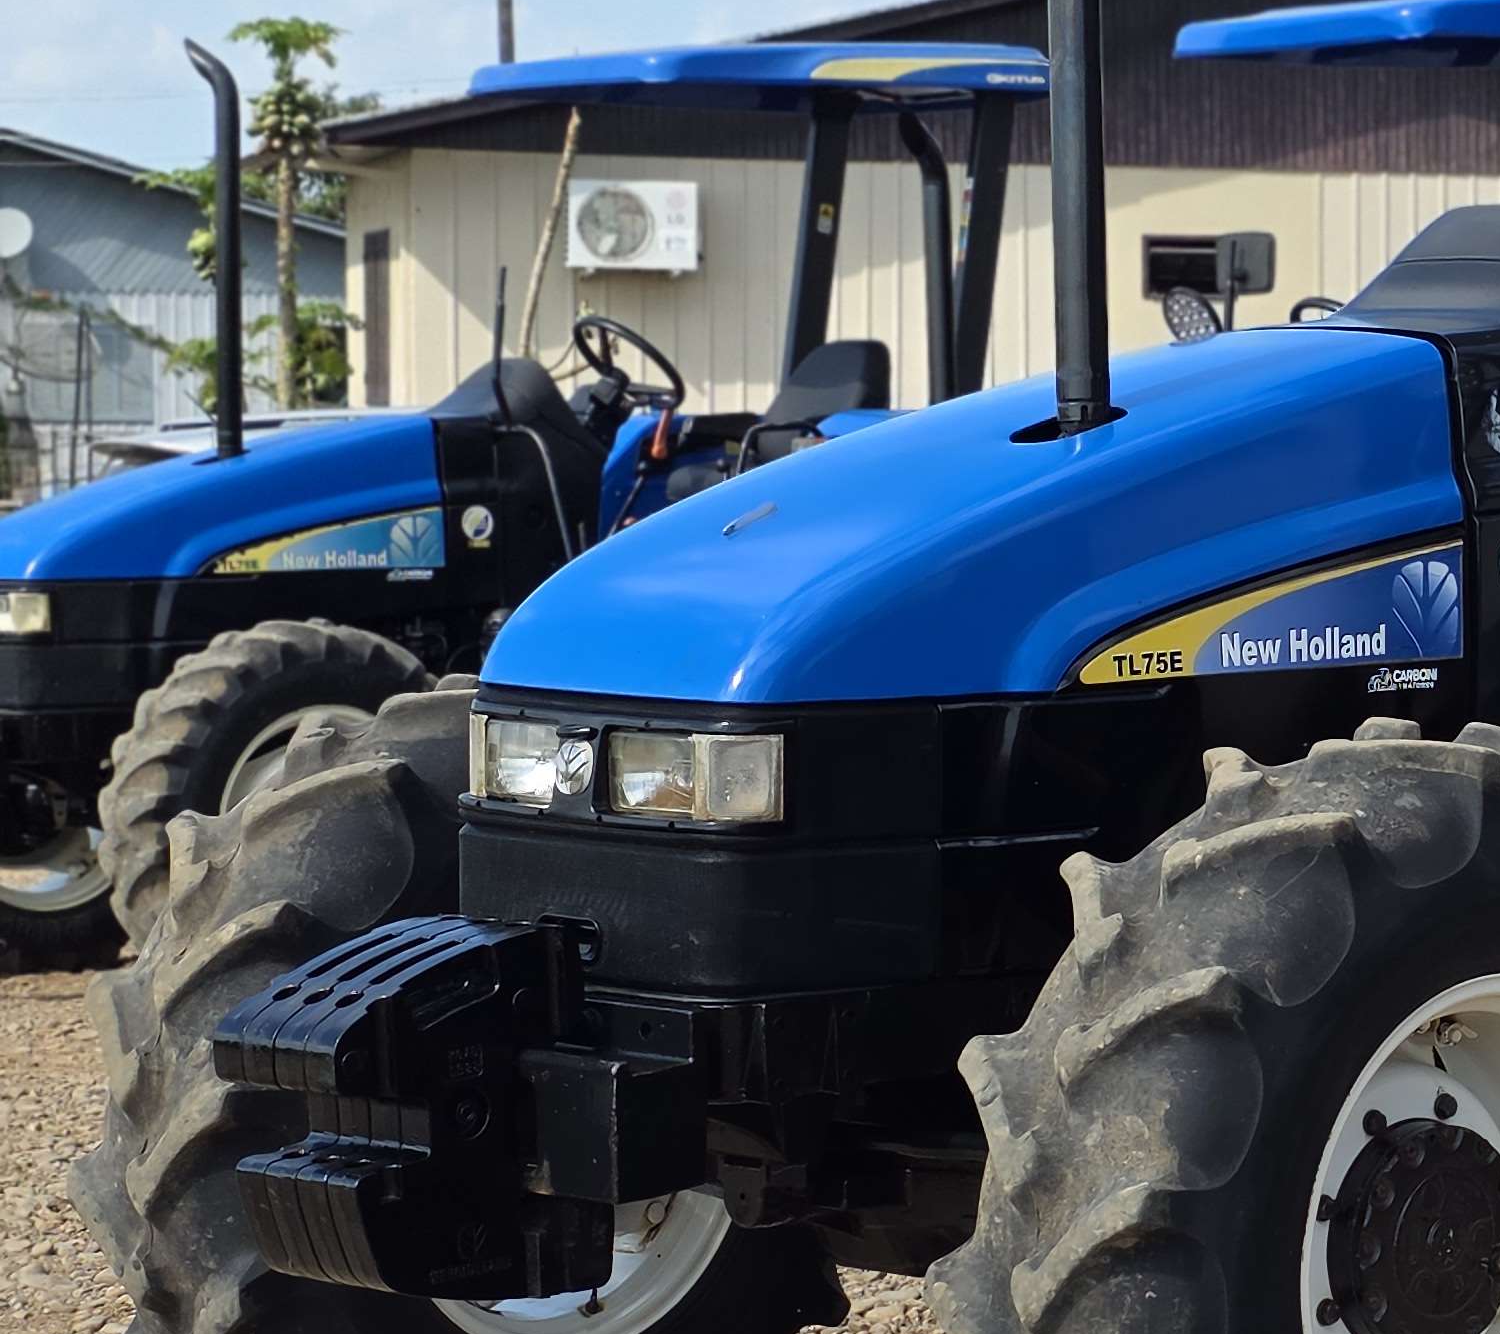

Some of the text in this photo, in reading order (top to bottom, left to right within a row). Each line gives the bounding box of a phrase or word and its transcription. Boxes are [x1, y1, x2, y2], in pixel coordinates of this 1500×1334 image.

[282, 549, 388, 568] New Holland
[1220, 623, 1387, 667] New Holland
[1112, 650, 1184, 678] TL75E
